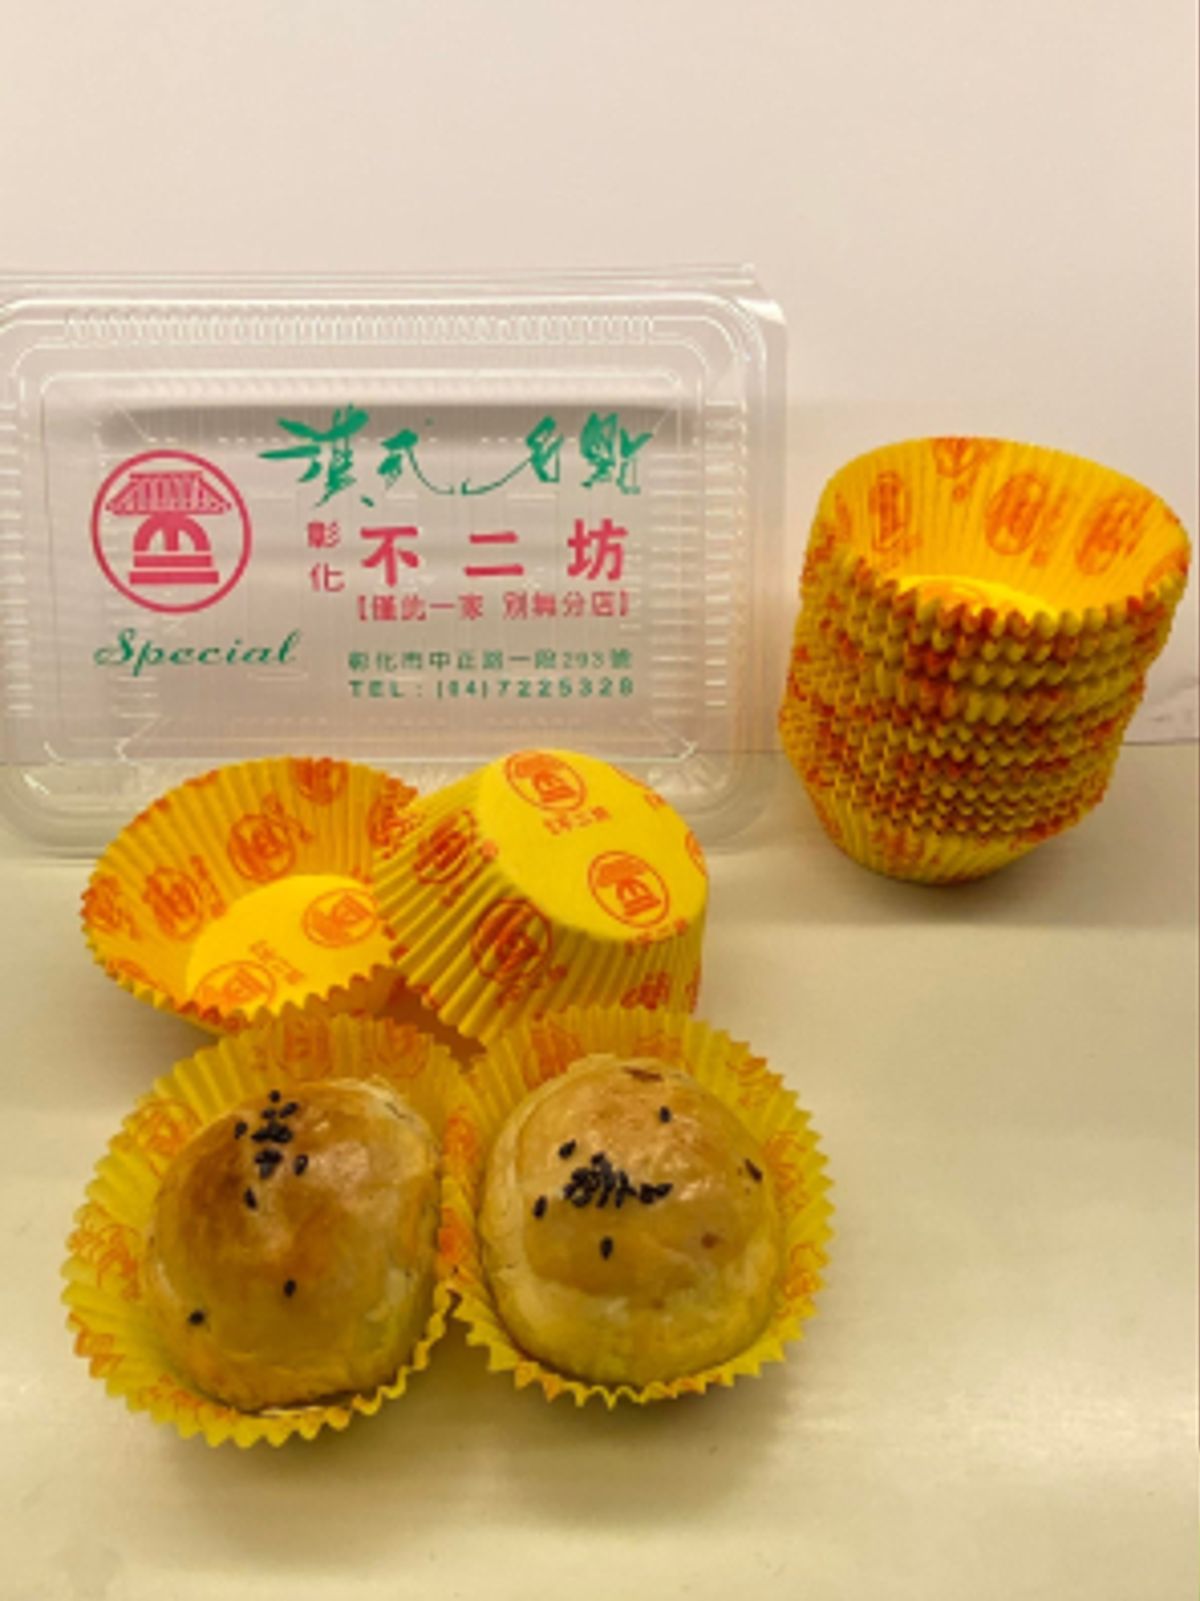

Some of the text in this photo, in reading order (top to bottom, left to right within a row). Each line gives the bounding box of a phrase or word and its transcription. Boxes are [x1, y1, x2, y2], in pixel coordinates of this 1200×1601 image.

[307, 521, 345, 593] 彰化
[360, 518, 628, 587] 不二坊
[93, 628, 300, 677] Special
